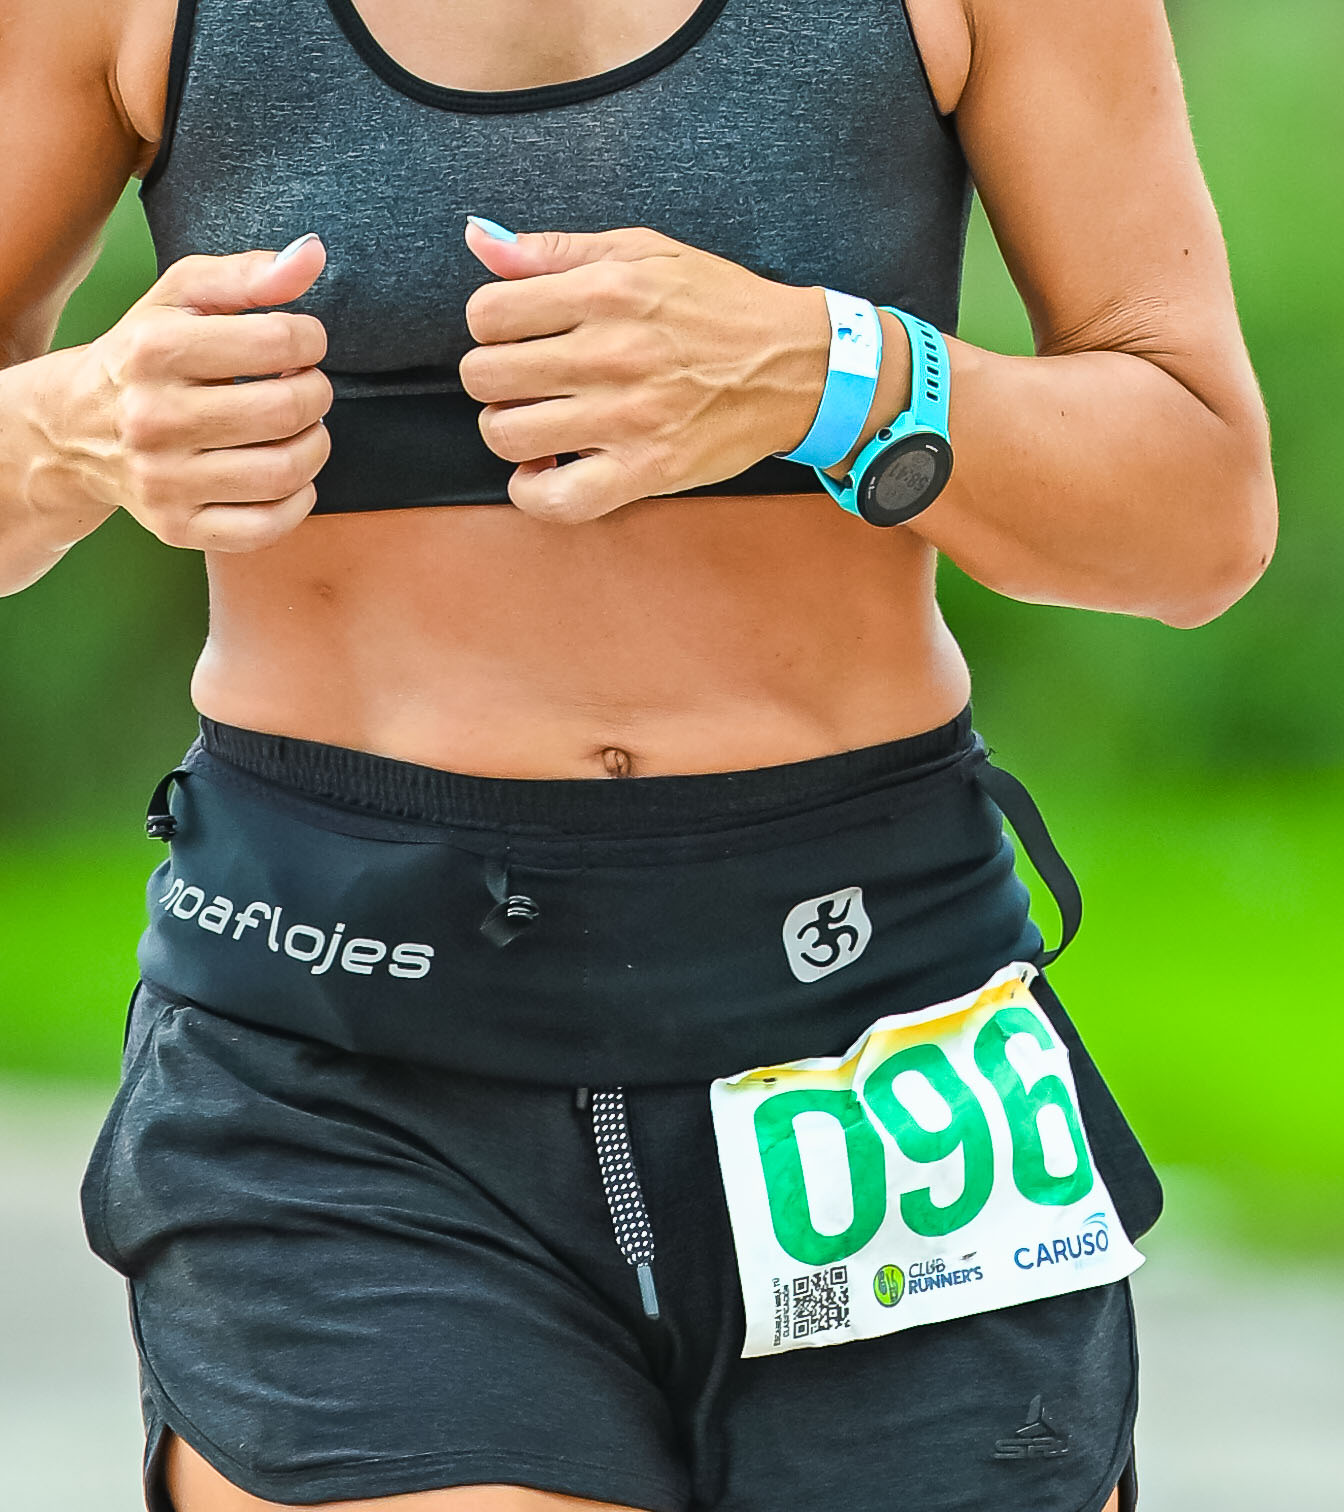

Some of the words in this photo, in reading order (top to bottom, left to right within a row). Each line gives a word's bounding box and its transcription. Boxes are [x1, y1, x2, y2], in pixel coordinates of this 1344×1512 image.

[158, 878, 435, 979] noaflojes
[753, 1007, 1094, 1266] 096
[908, 1257, 946, 1278] CLUB
[1014, 1229, 1108, 1270] CARUSO
[908, 1266, 983, 1294] RUNNER'S
